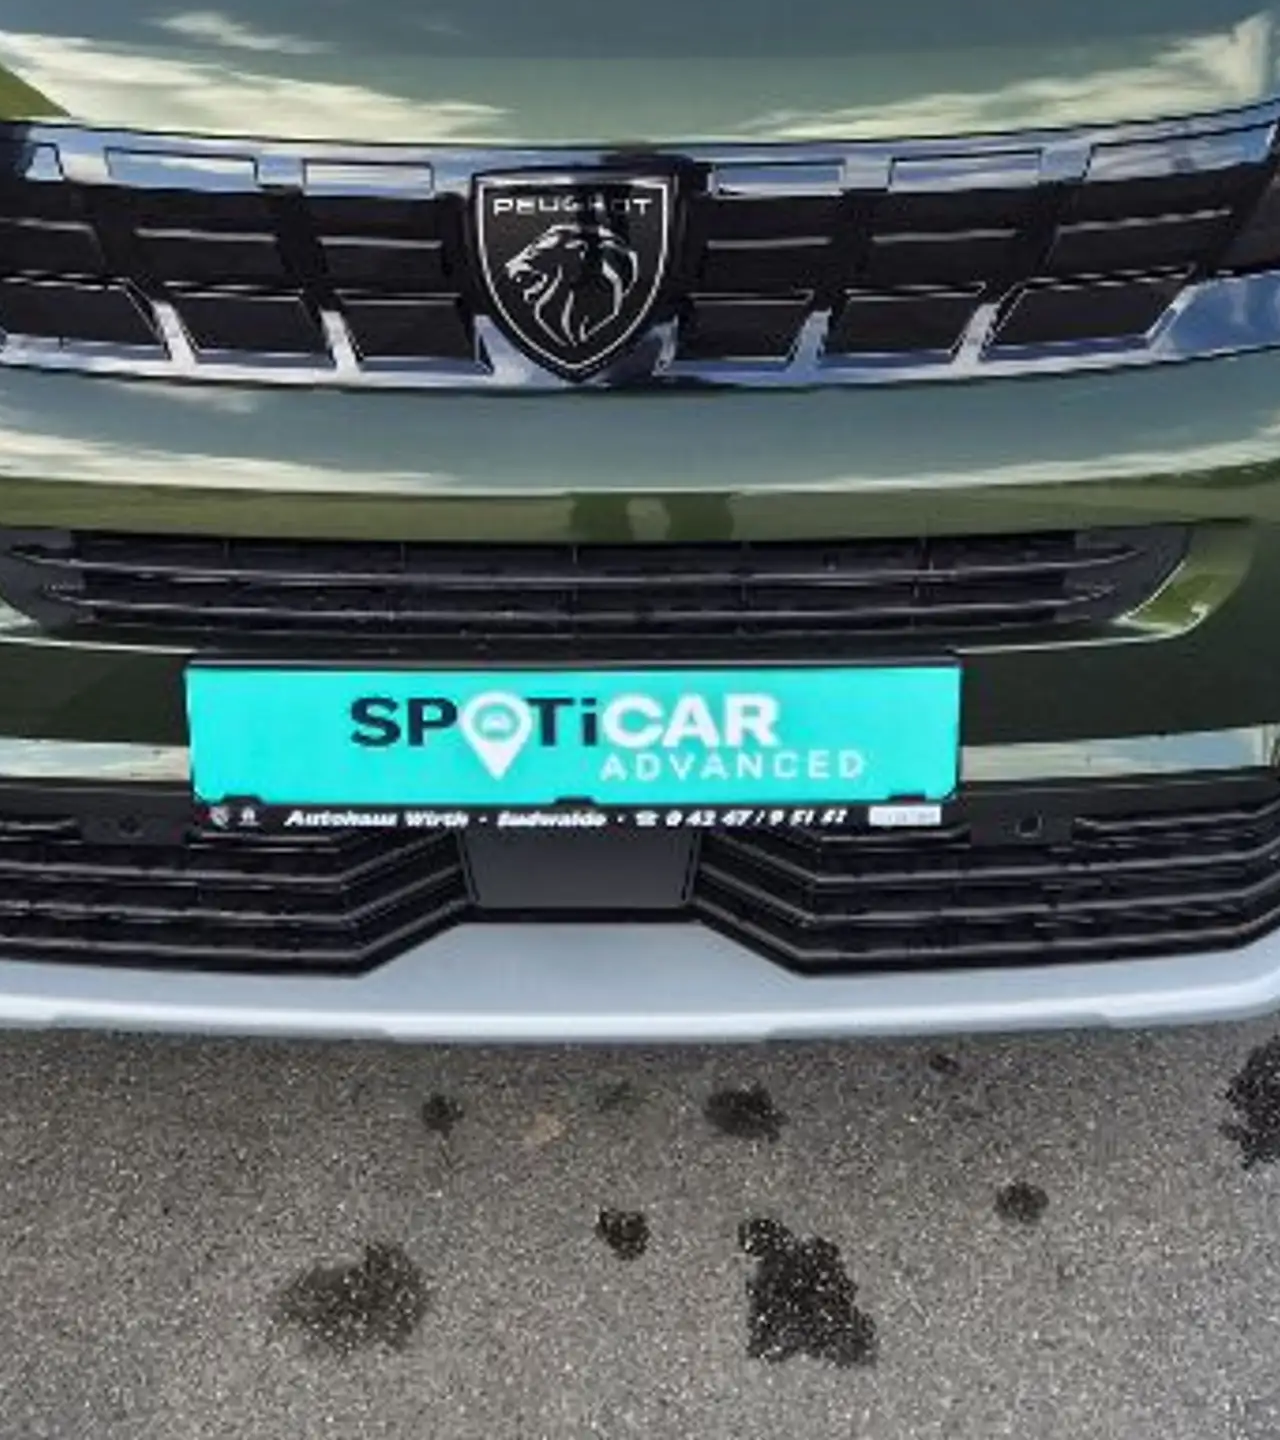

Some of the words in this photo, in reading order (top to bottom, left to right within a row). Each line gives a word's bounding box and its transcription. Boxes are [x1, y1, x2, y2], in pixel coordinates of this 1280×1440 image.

[599, 749, 865, 782] ADVANCED
[284, 809, 398, 827] Autohaus
[403, 810, 469, 828] Wirth
